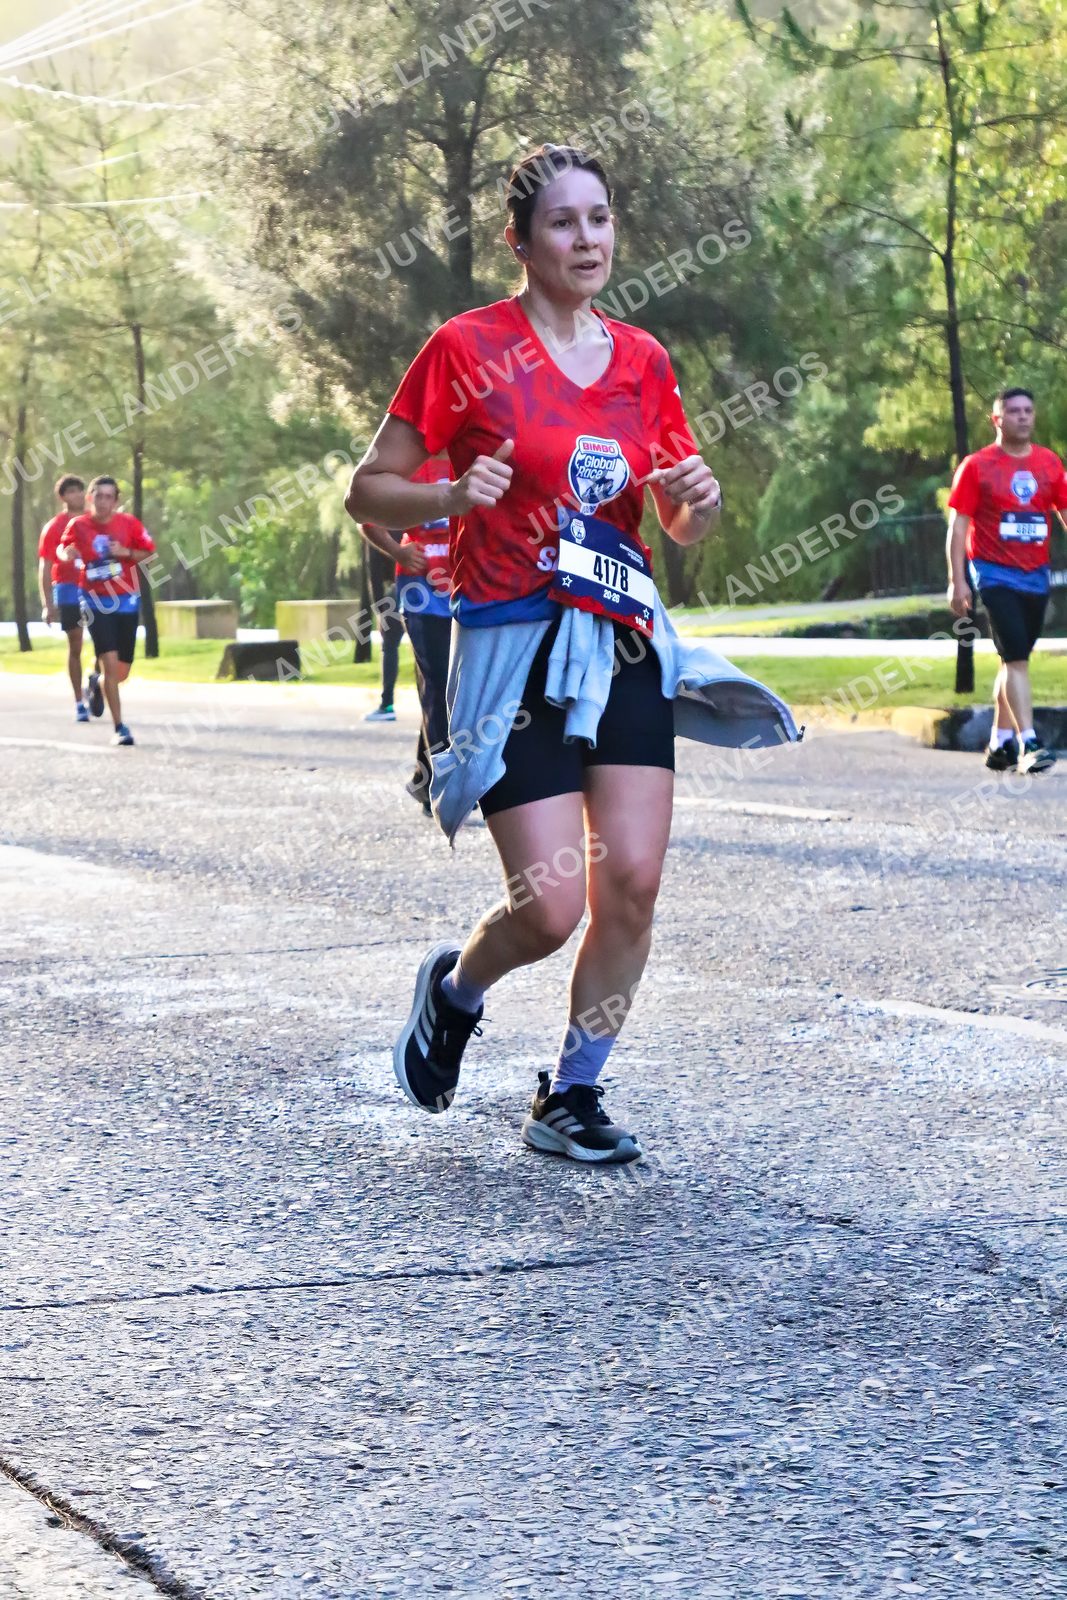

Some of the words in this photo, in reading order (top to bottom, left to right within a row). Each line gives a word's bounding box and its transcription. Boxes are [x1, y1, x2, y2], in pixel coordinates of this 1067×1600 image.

[582, 442, 616, 454] BIMBO
[584, 455, 617, 471] Global
[576, 466, 603, 479] Race
[593, 554, 629, 593] 4178
[602, 589, 621, 604] 20-26
